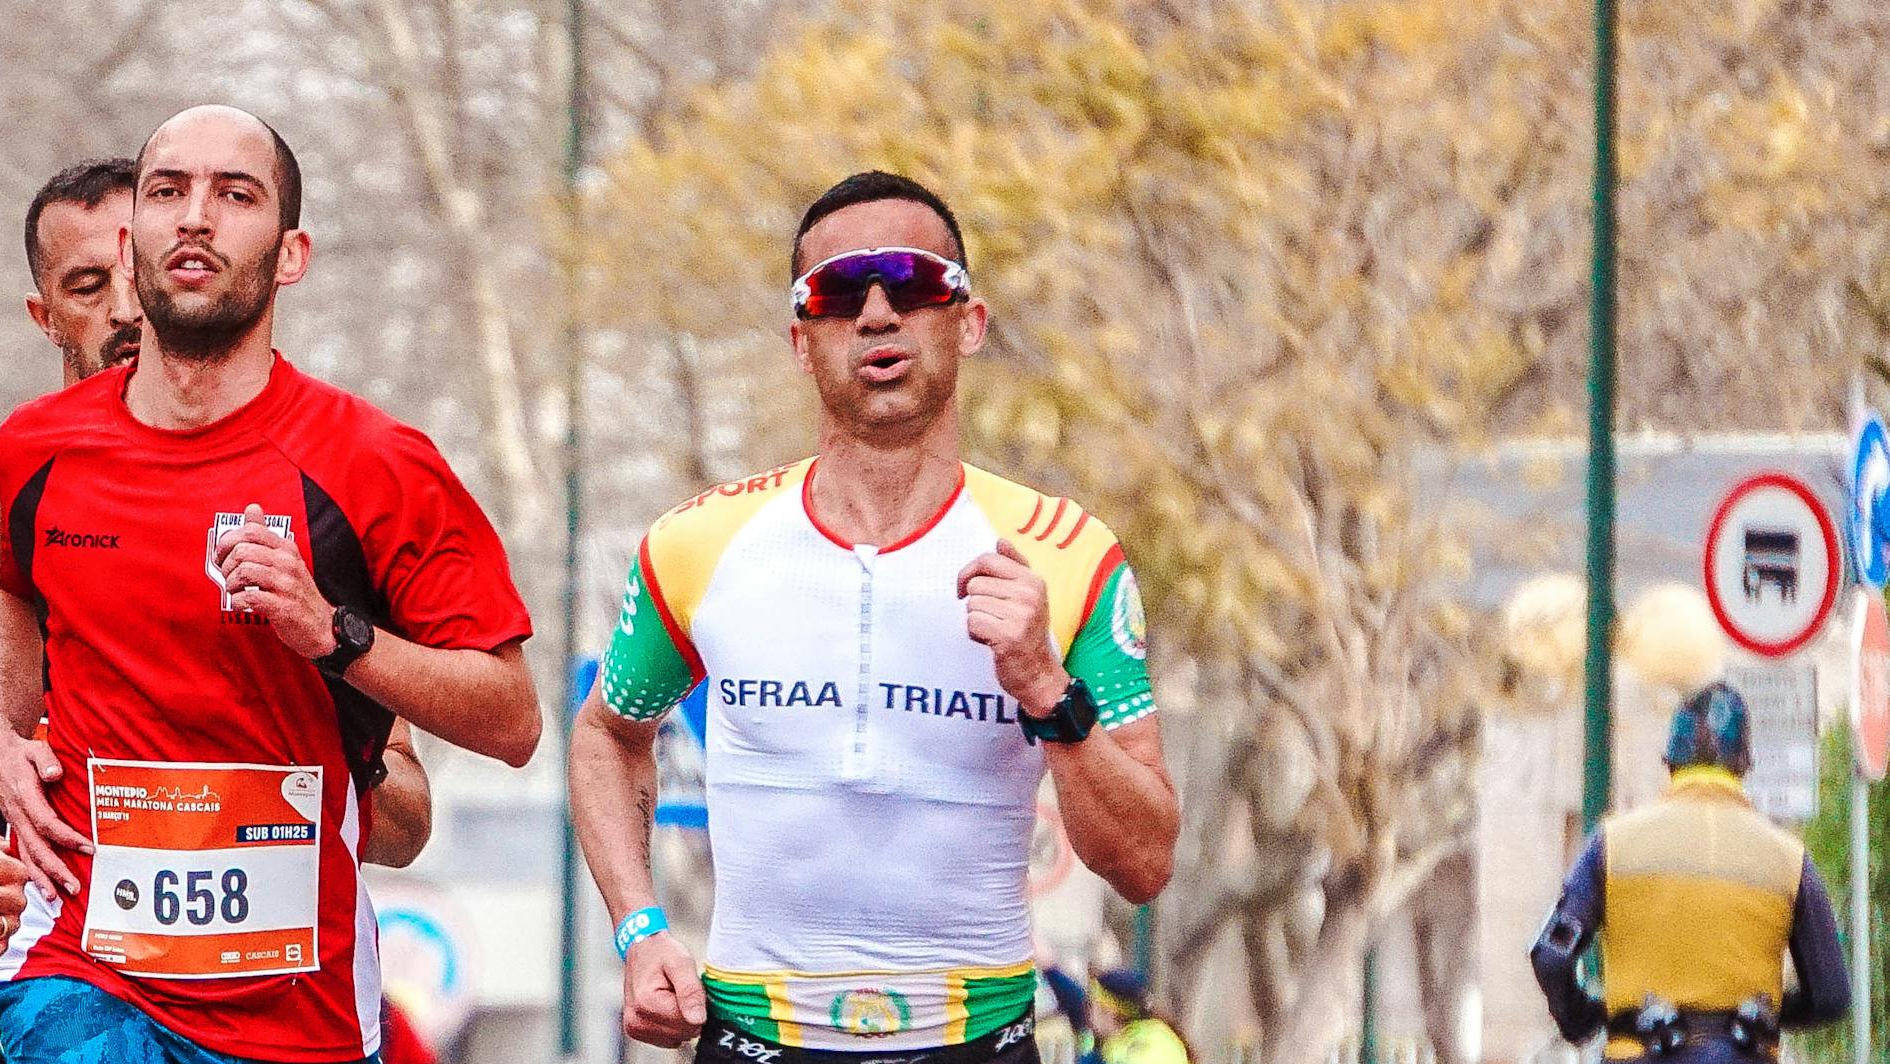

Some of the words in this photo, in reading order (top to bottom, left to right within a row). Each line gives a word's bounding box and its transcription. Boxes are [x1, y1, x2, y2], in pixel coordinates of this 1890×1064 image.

[221, 514, 241, 525] CLUBE
[720, 678, 843, 708] SFRAA
[879, 682, 1020, 724] TRIATL
[96, 785, 148, 799] MONTEPIO
[96, 797, 120, 807] MEIA
[124, 800, 174, 811] MARATONA
[176, 803, 221, 812] CASCAIS
[245, 827, 269, 840] SUB
[272, 825, 309, 839] 01H25
[153, 868, 249, 926] 658
